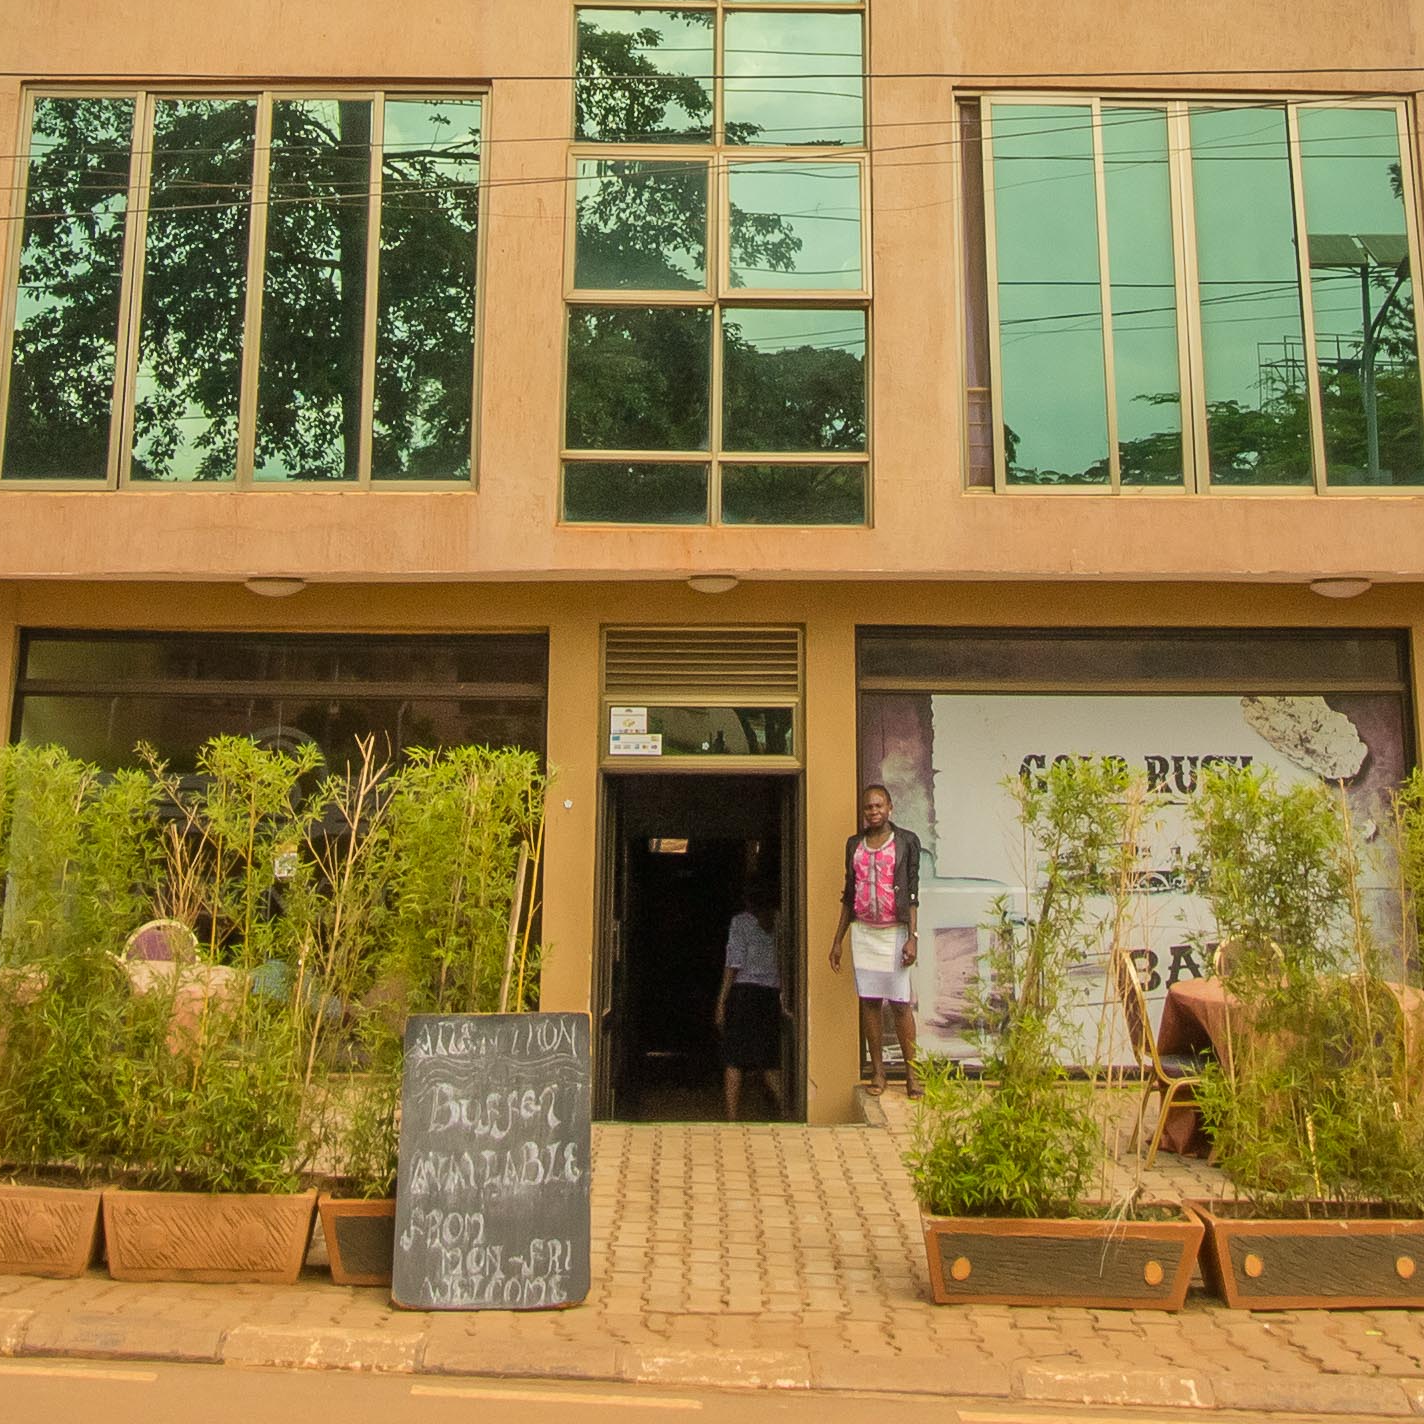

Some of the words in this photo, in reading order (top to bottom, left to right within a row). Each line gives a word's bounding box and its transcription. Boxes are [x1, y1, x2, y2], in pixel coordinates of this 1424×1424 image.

[1018, 754, 1129, 793] GOD
[1119, 942, 1219, 992] BA
[408, 1141, 583, 1194] AVAILABLE
[400, 1207, 485, 1251] FROM
